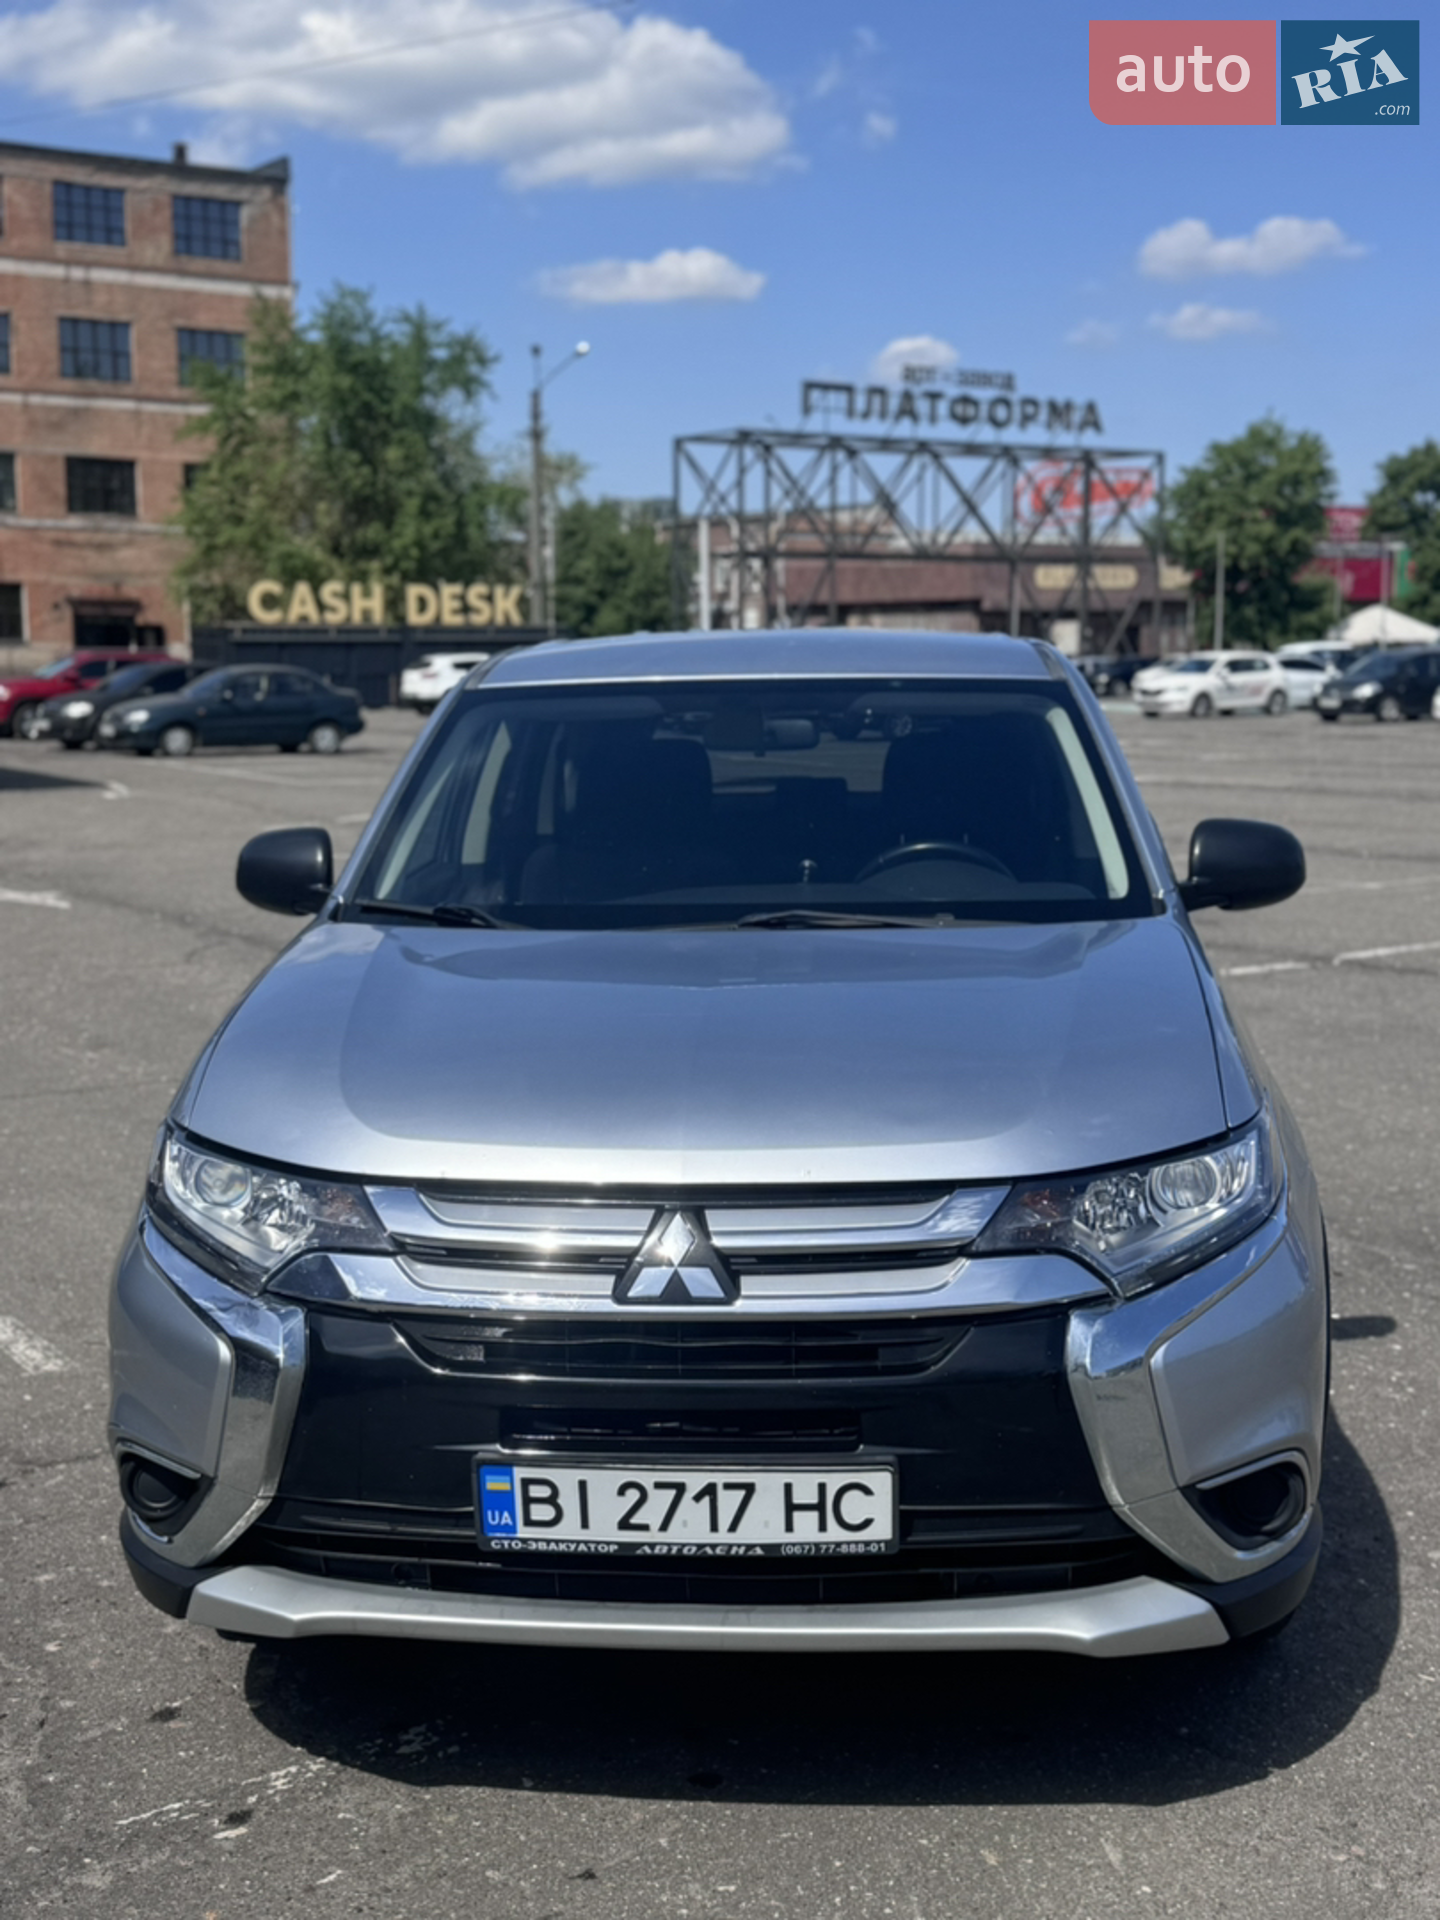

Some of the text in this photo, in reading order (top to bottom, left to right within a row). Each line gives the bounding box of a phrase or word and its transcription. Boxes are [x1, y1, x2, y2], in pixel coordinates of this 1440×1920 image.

[801, 380, 1103, 434] ПЛАТФОРМА
[246, 579, 523, 627] CASH DESK
[487, 1511, 513, 1526] UA
[520, 1477, 876, 1533] BI 2717 HC
[490, 1539, 619, 1554] СТО-ЭВАКУАТОР
[780, 1543, 816, 1556] (067)
[819, 1542, 887, 1555] 77-888-01
